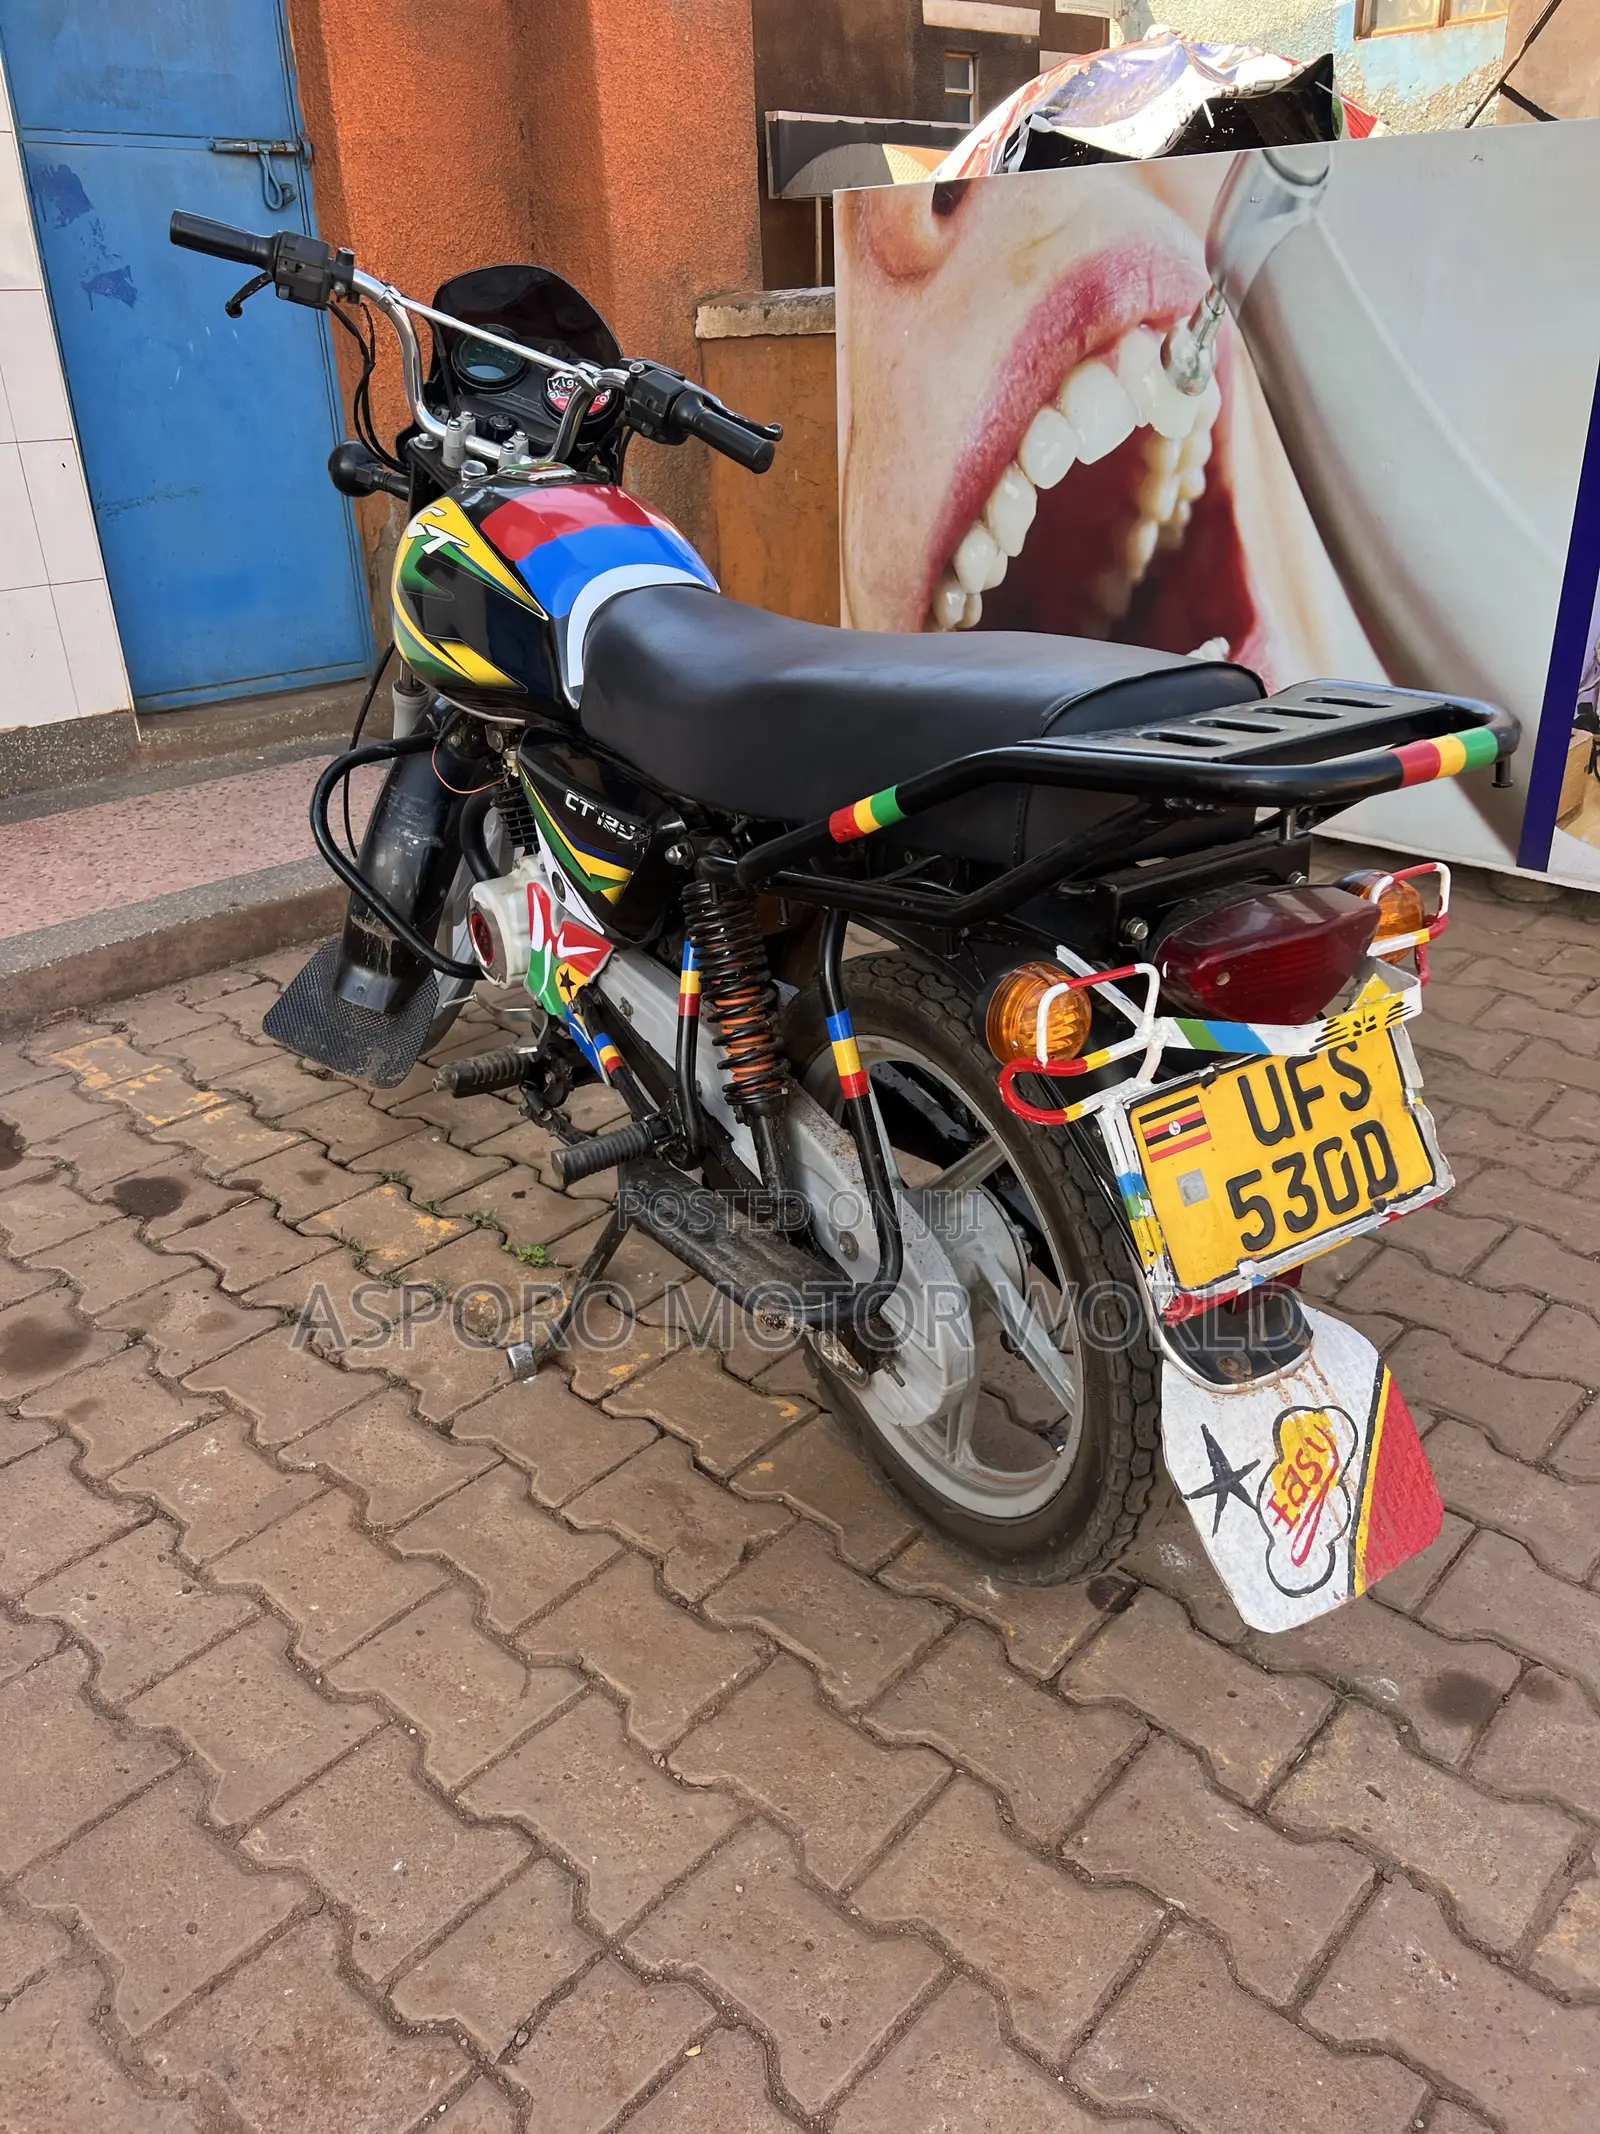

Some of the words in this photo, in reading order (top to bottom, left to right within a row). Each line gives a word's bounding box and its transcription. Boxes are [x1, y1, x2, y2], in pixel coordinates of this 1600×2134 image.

[407, 506, 470, 554] CT
[1237, 1041, 1371, 1146] UFS
[1226, 1120, 1398, 1251] 530D
